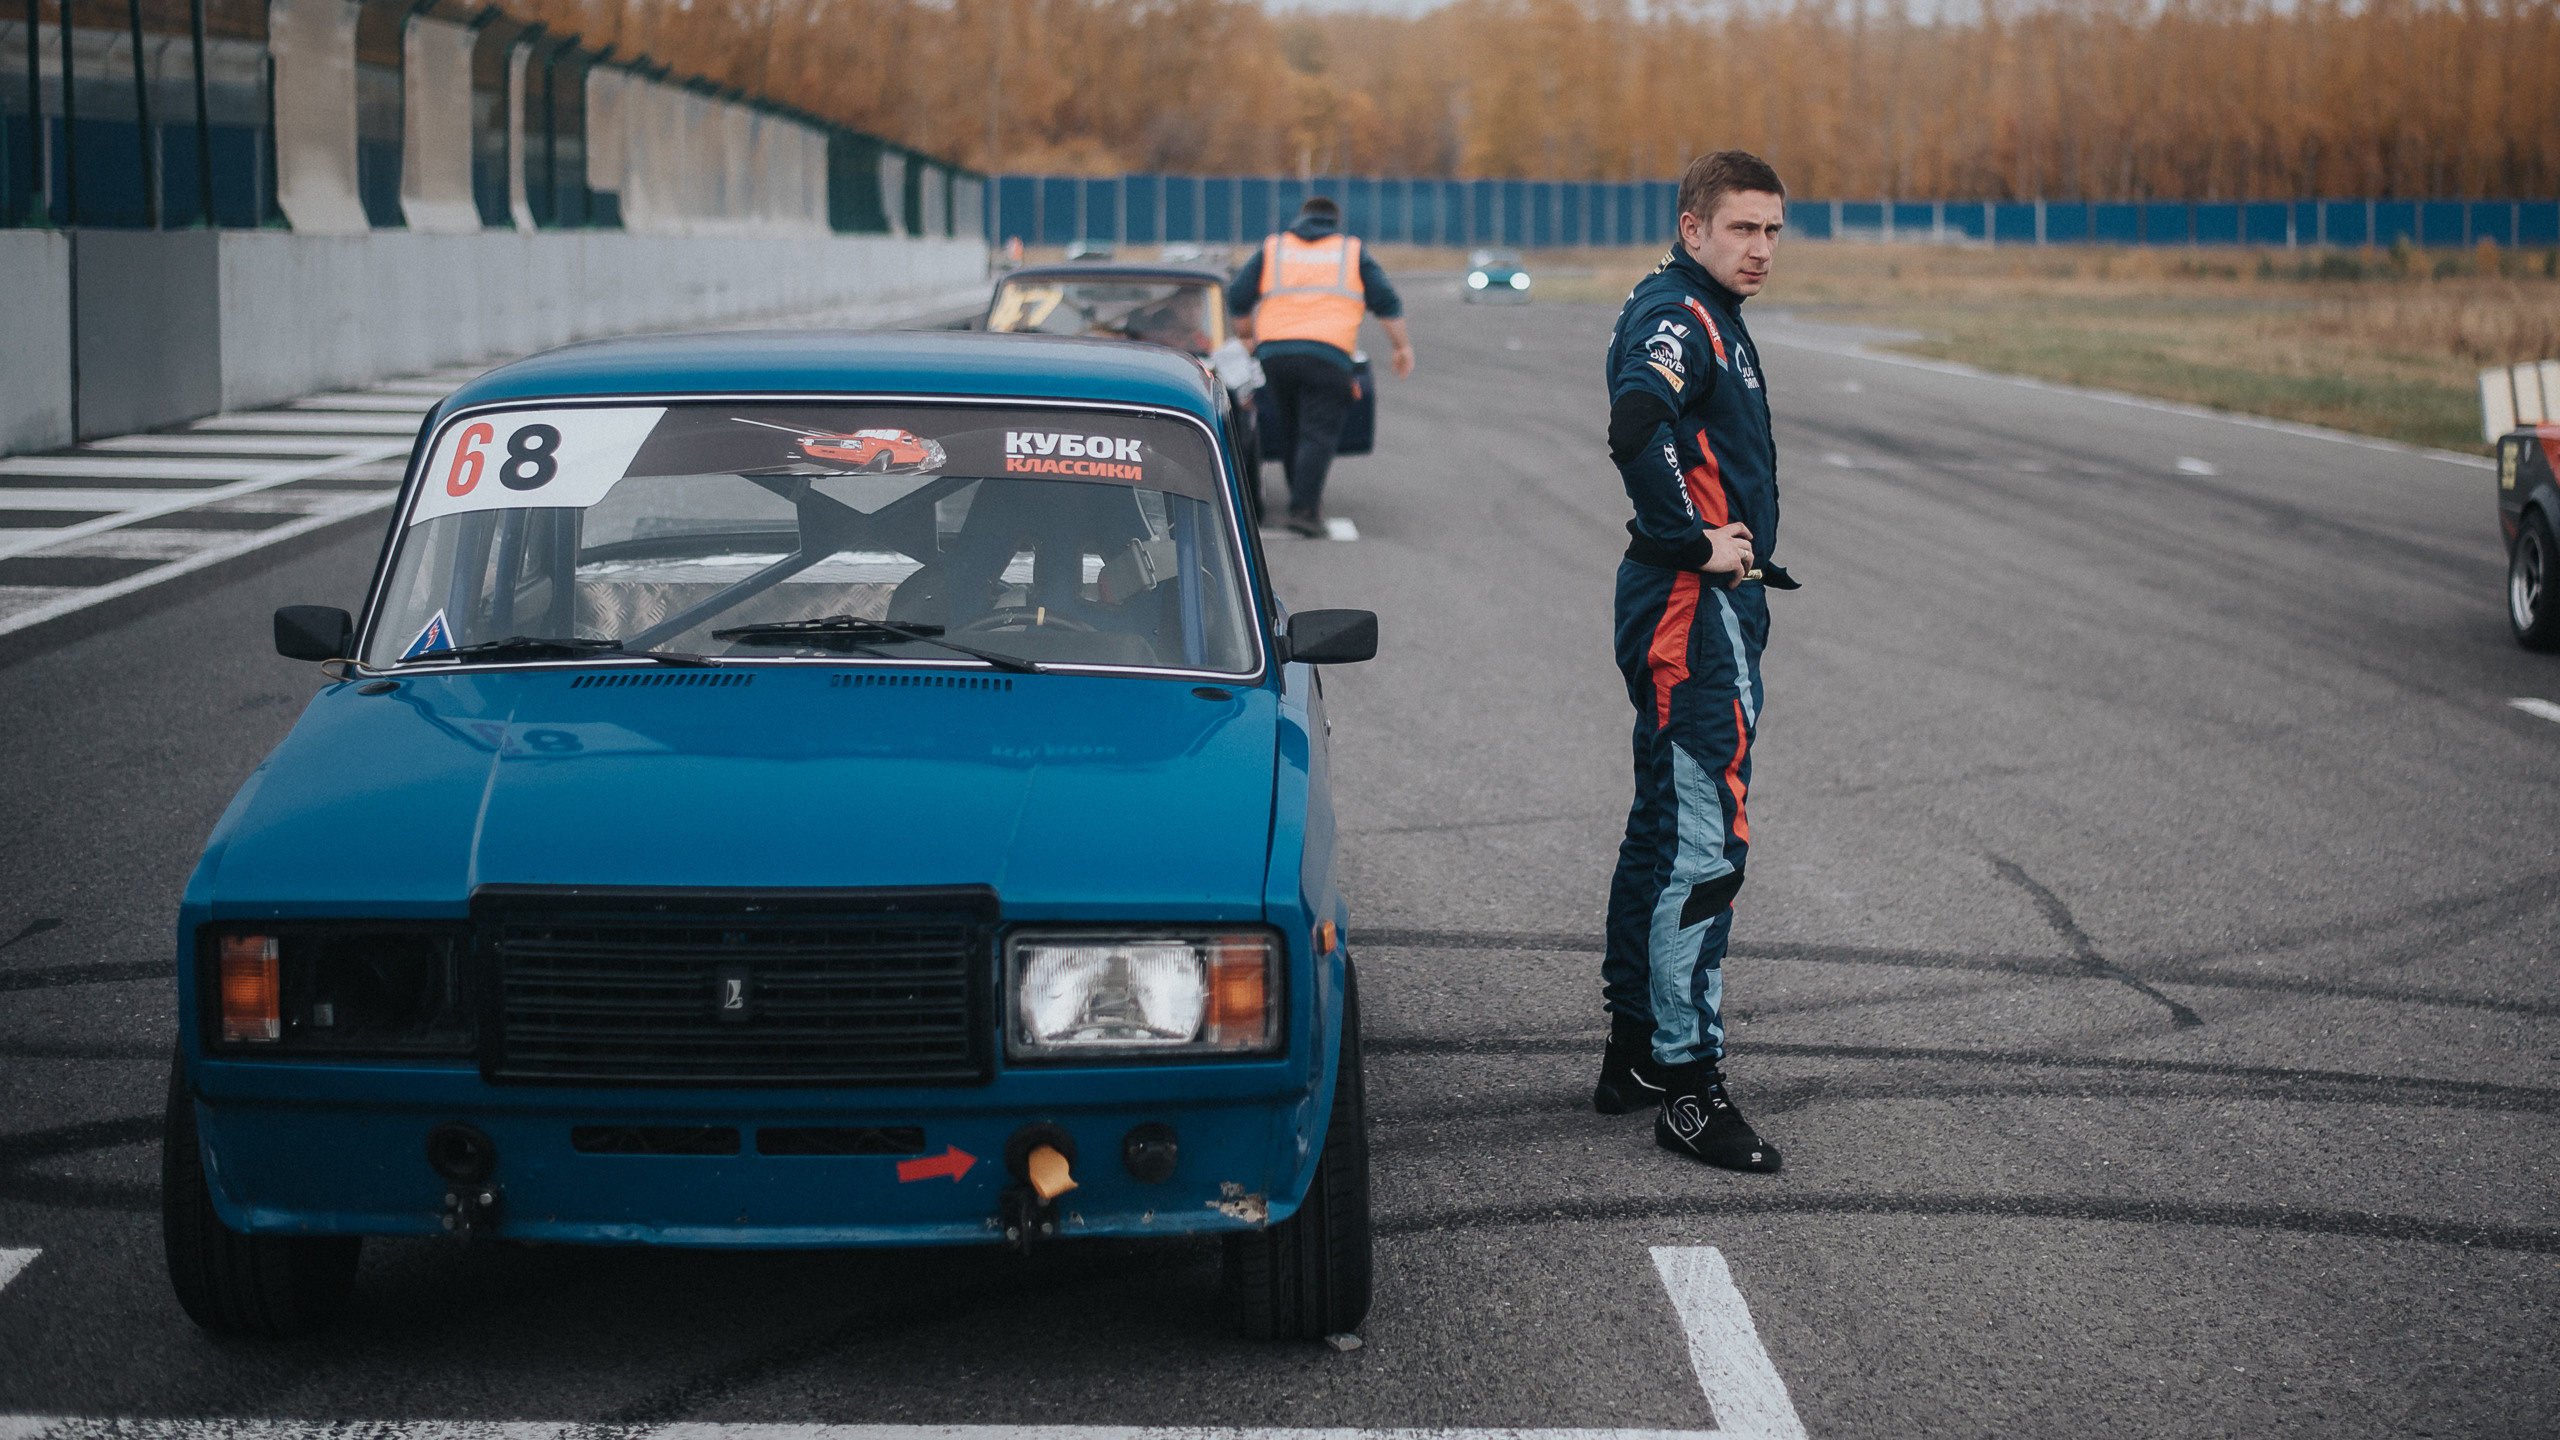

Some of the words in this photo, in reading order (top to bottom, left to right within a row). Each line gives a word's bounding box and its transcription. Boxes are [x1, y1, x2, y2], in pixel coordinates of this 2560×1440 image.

[446, 422, 562, 497] 68
[1006, 431, 1143, 462] КУБОК
[1006, 457, 1143, 480] КЛАССИКИ
